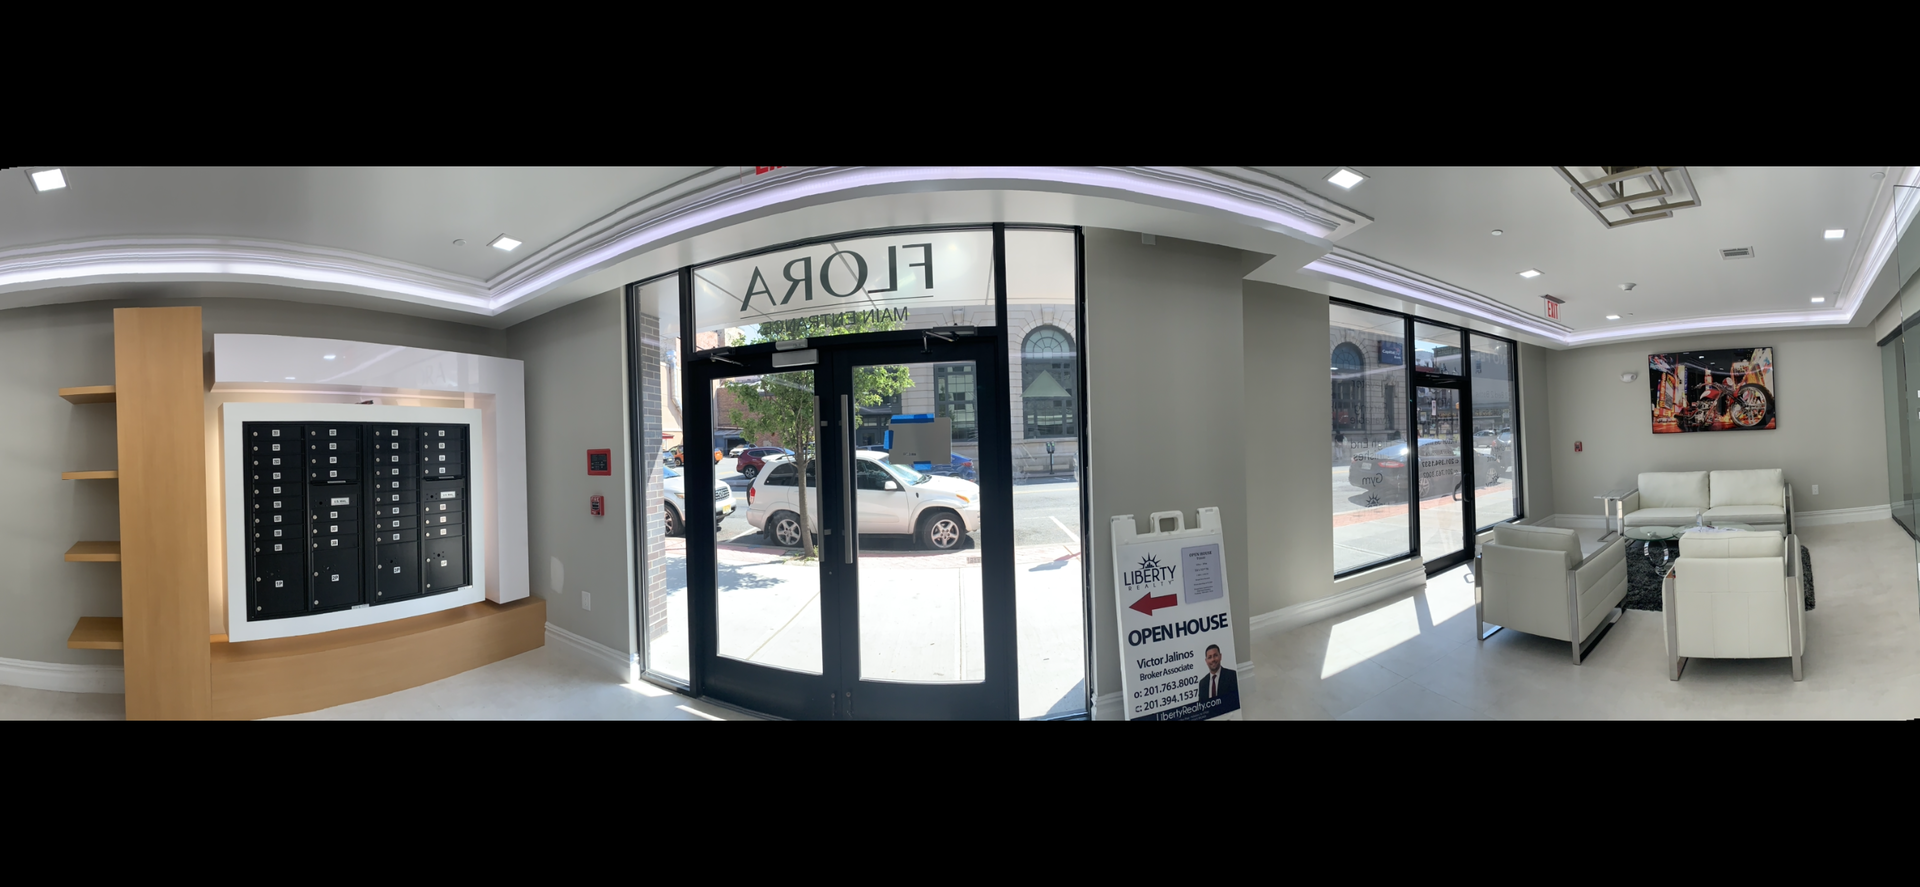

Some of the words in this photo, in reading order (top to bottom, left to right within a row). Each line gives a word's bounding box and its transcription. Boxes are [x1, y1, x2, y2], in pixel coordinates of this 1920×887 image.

[1547, 300, 1558, 320] EXIT
[1124, 565, 1176, 586] LIBERTY
[1128, 580, 1174, 591] REALTY
[1128, 623, 1174, 647] OPEN
[1175, 612, 1229, 638] HOUSE
[1136, 657, 1164, 669] Victor
[1164, 650, 1194, 664] Jalinos
[1139, 671, 1163, 682] Broker
[1163, 663, 1194, 676] Associate
[1133, 690, 1142, 699] o:
[1143, 675, 1199, 697] 201.763.8002
[1135, 705, 1143, 713] c:
[1143, 688, 1199, 711] 201.394.1537
[1156, 698, 1222, 721] LibertyRealty.com
